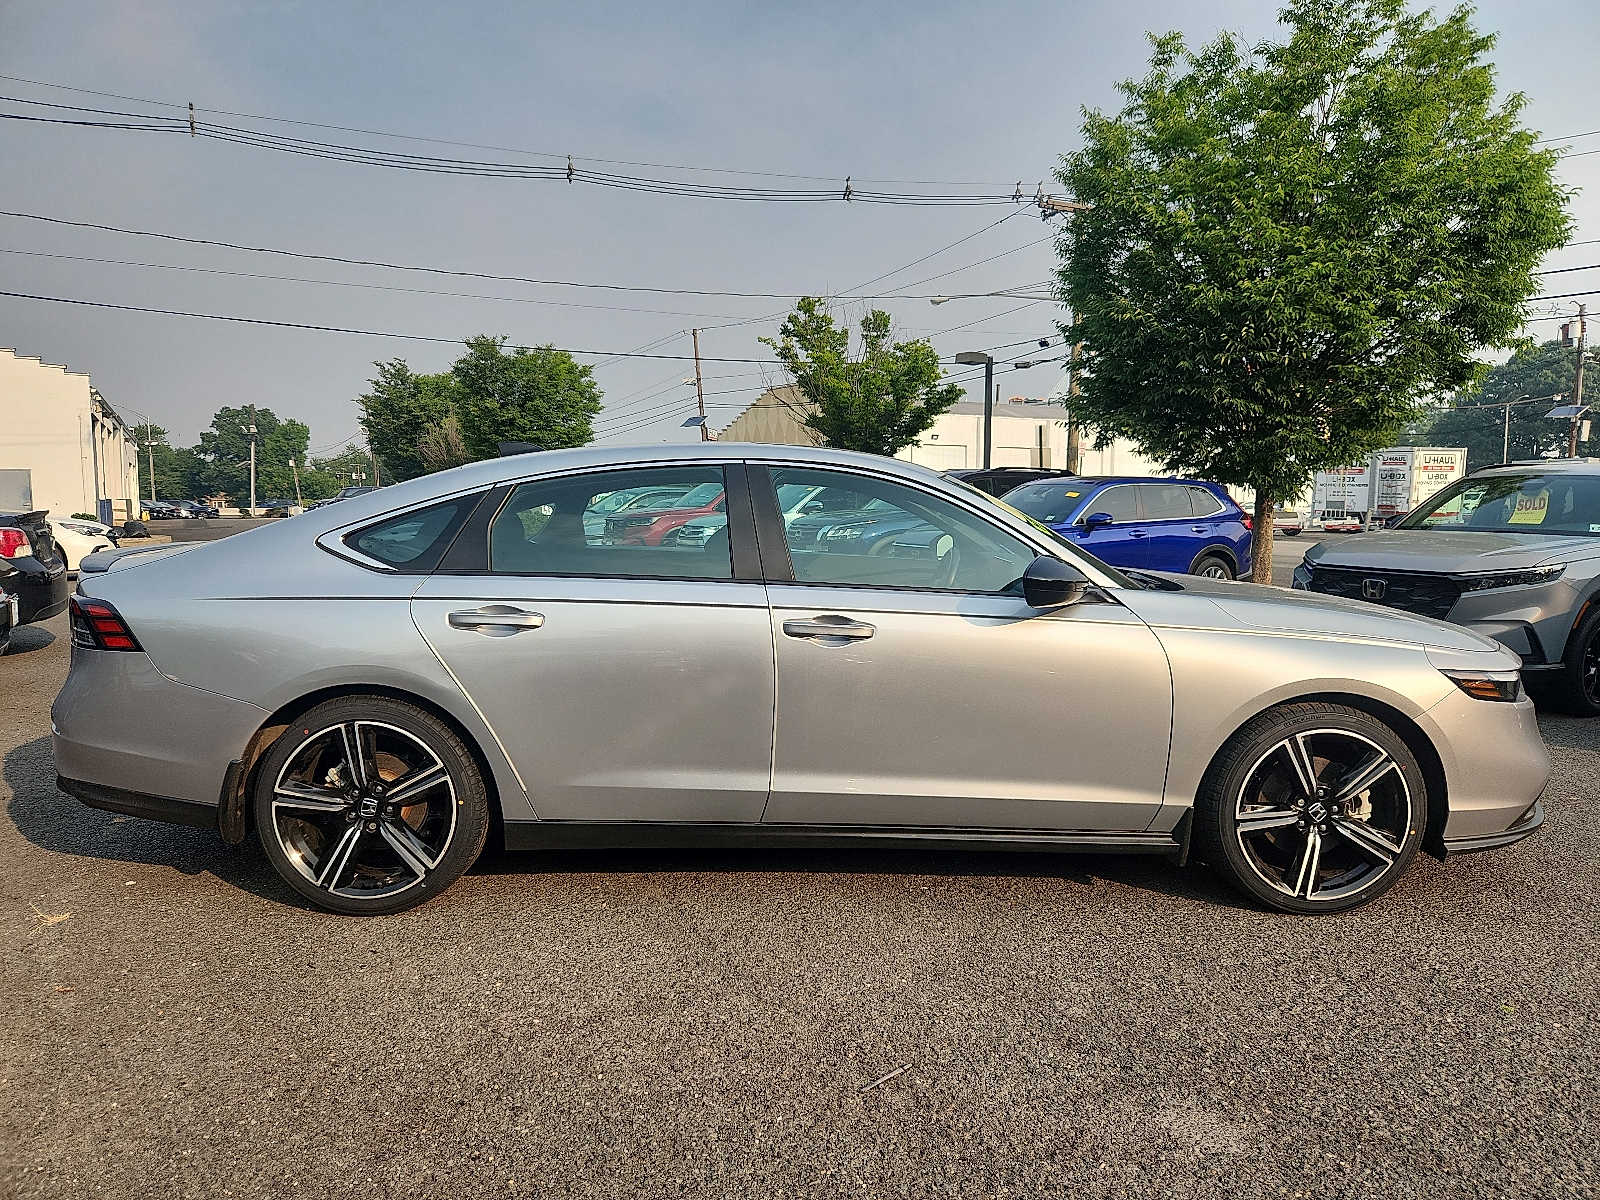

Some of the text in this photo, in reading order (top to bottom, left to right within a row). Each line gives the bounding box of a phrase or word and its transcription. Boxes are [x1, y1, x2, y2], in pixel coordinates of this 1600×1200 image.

[1424, 455, 1455, 464] U-HAUL
[1380, 472, 1407, 480] U-BOX
[1517, 497, 1546, 512] SOLD
